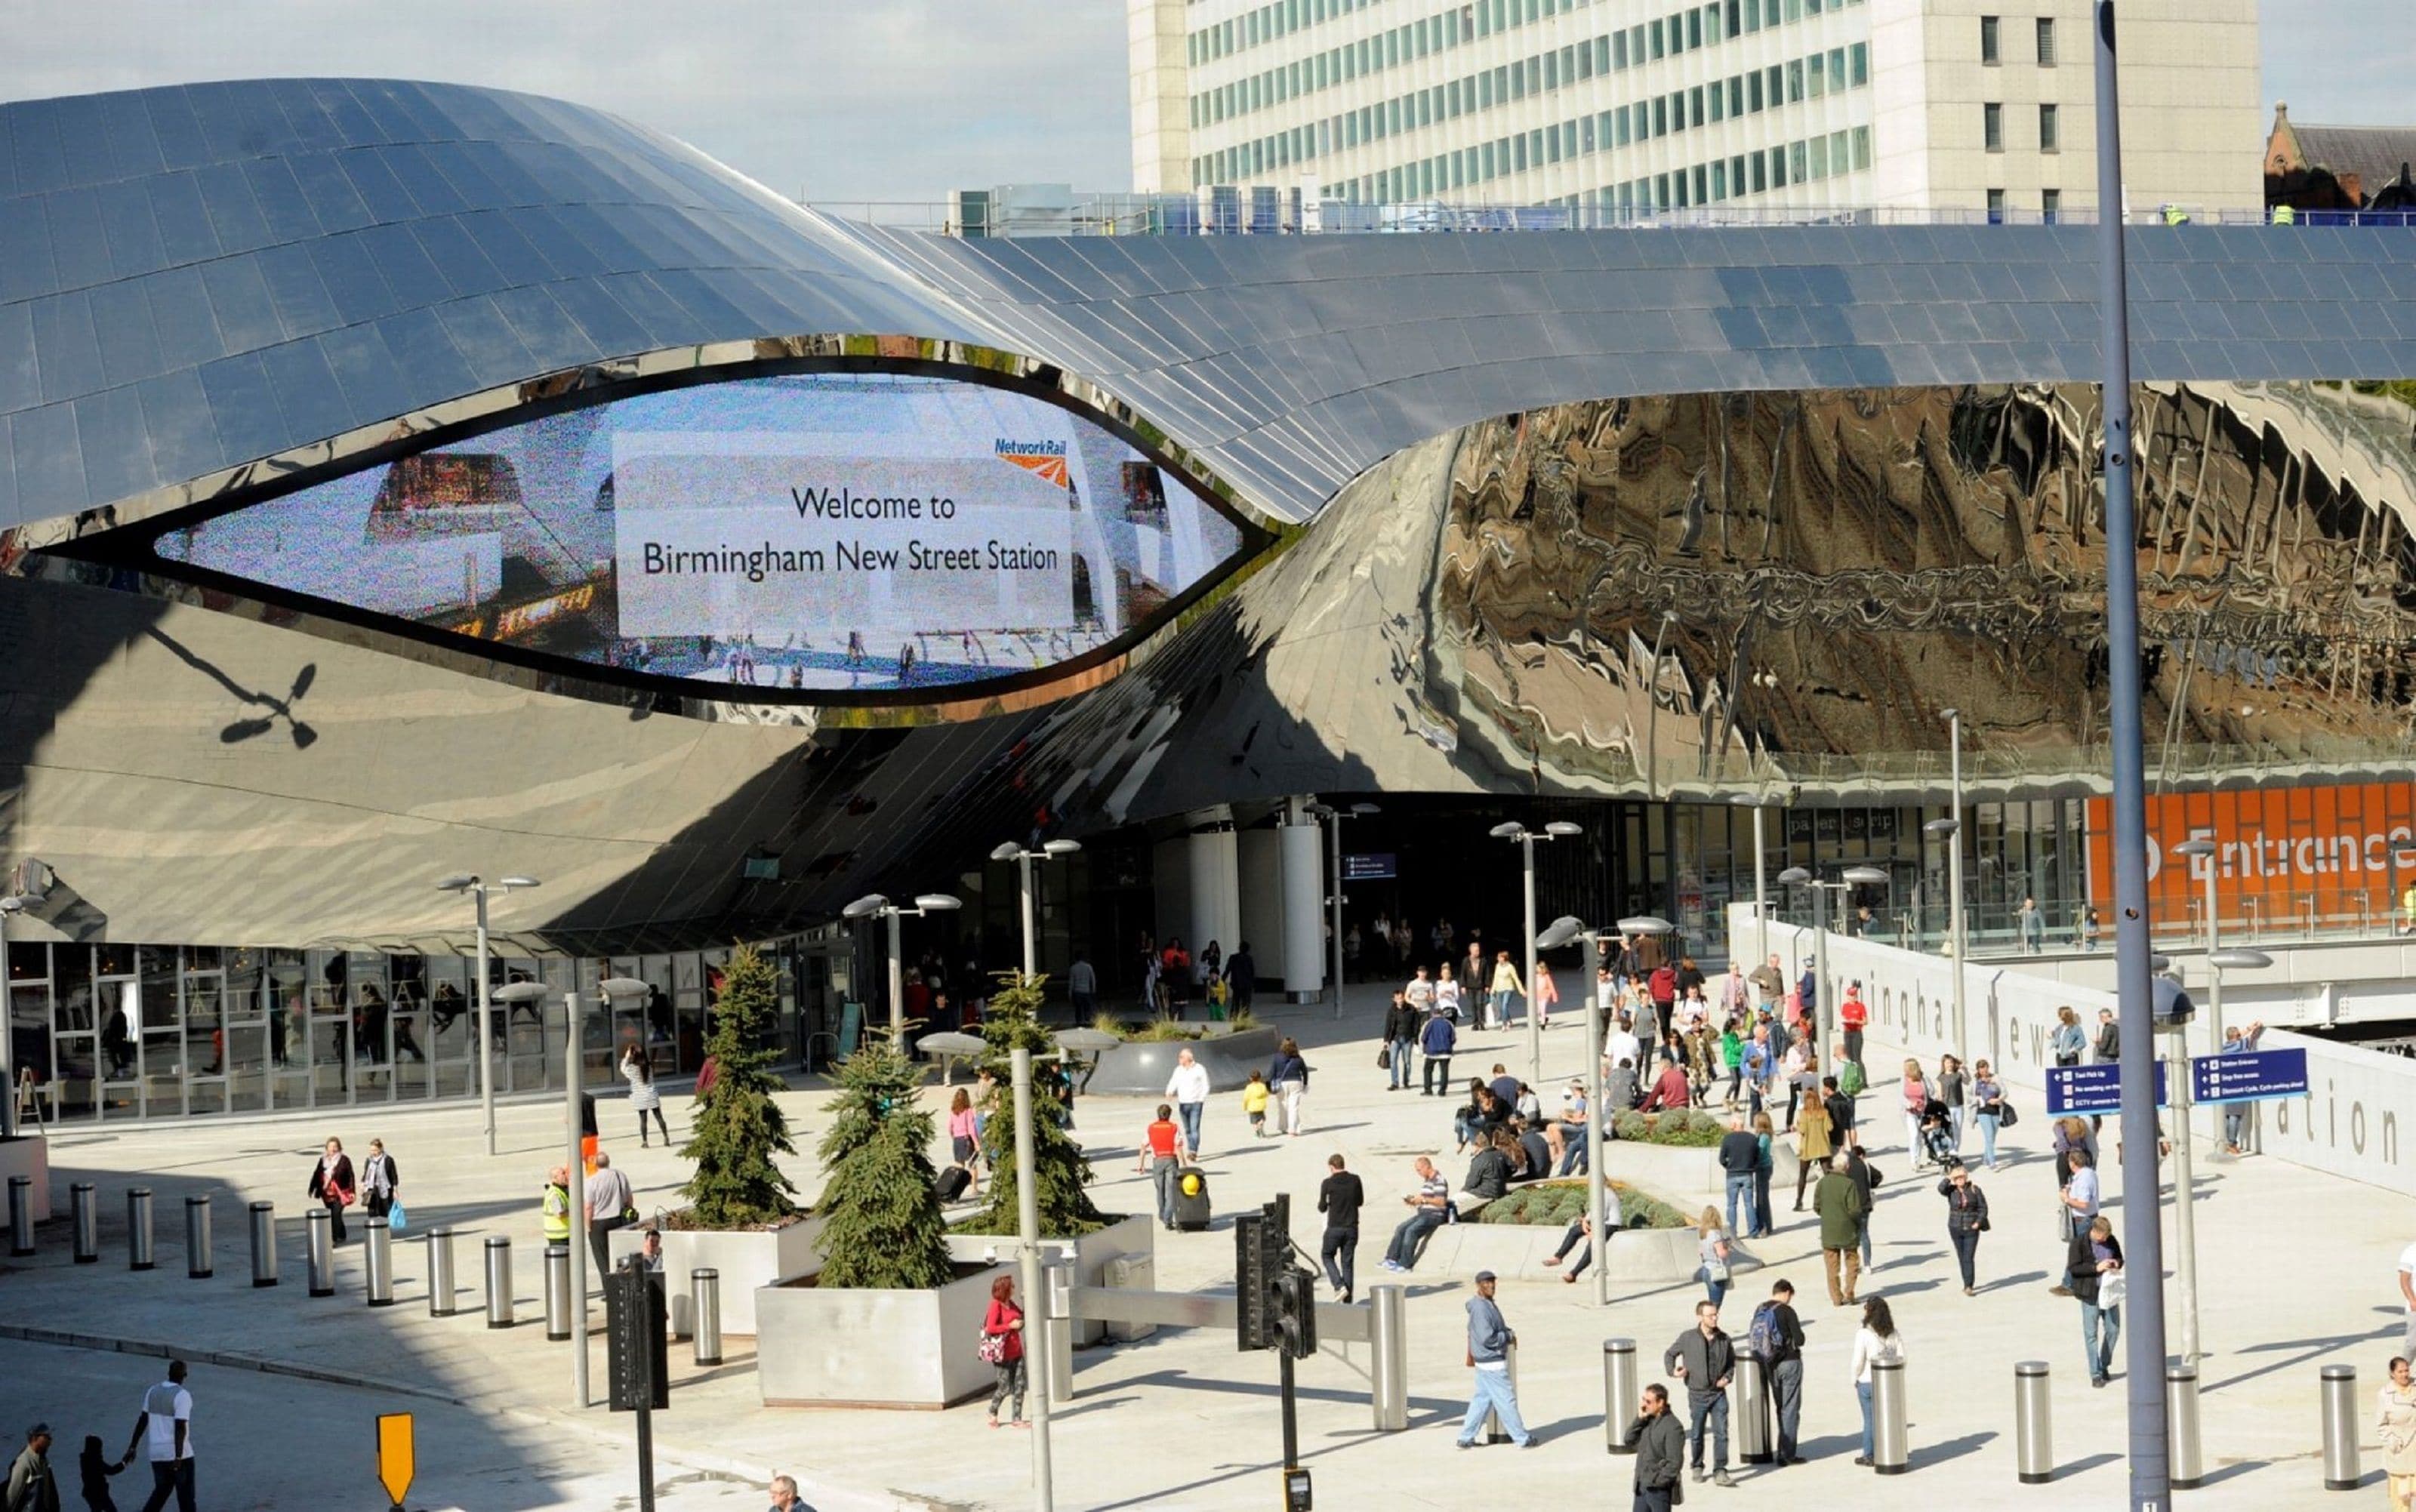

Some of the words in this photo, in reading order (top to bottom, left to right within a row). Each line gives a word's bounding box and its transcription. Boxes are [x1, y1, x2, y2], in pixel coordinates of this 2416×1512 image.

[791, 486, 922, 519] Welcome
[930, 495, 956, 519] to
[643, 540, 824, 583] Birmingham
[835, 540, 899, 572] New
[908, 539, 981, 571] Street
[987, 539, 1058, 571] Station
[1790, 818, 1836, 833] paer
[2190, 826, 2416, 880] Entrance
[2277, 1076, 2398, 1166] ation
